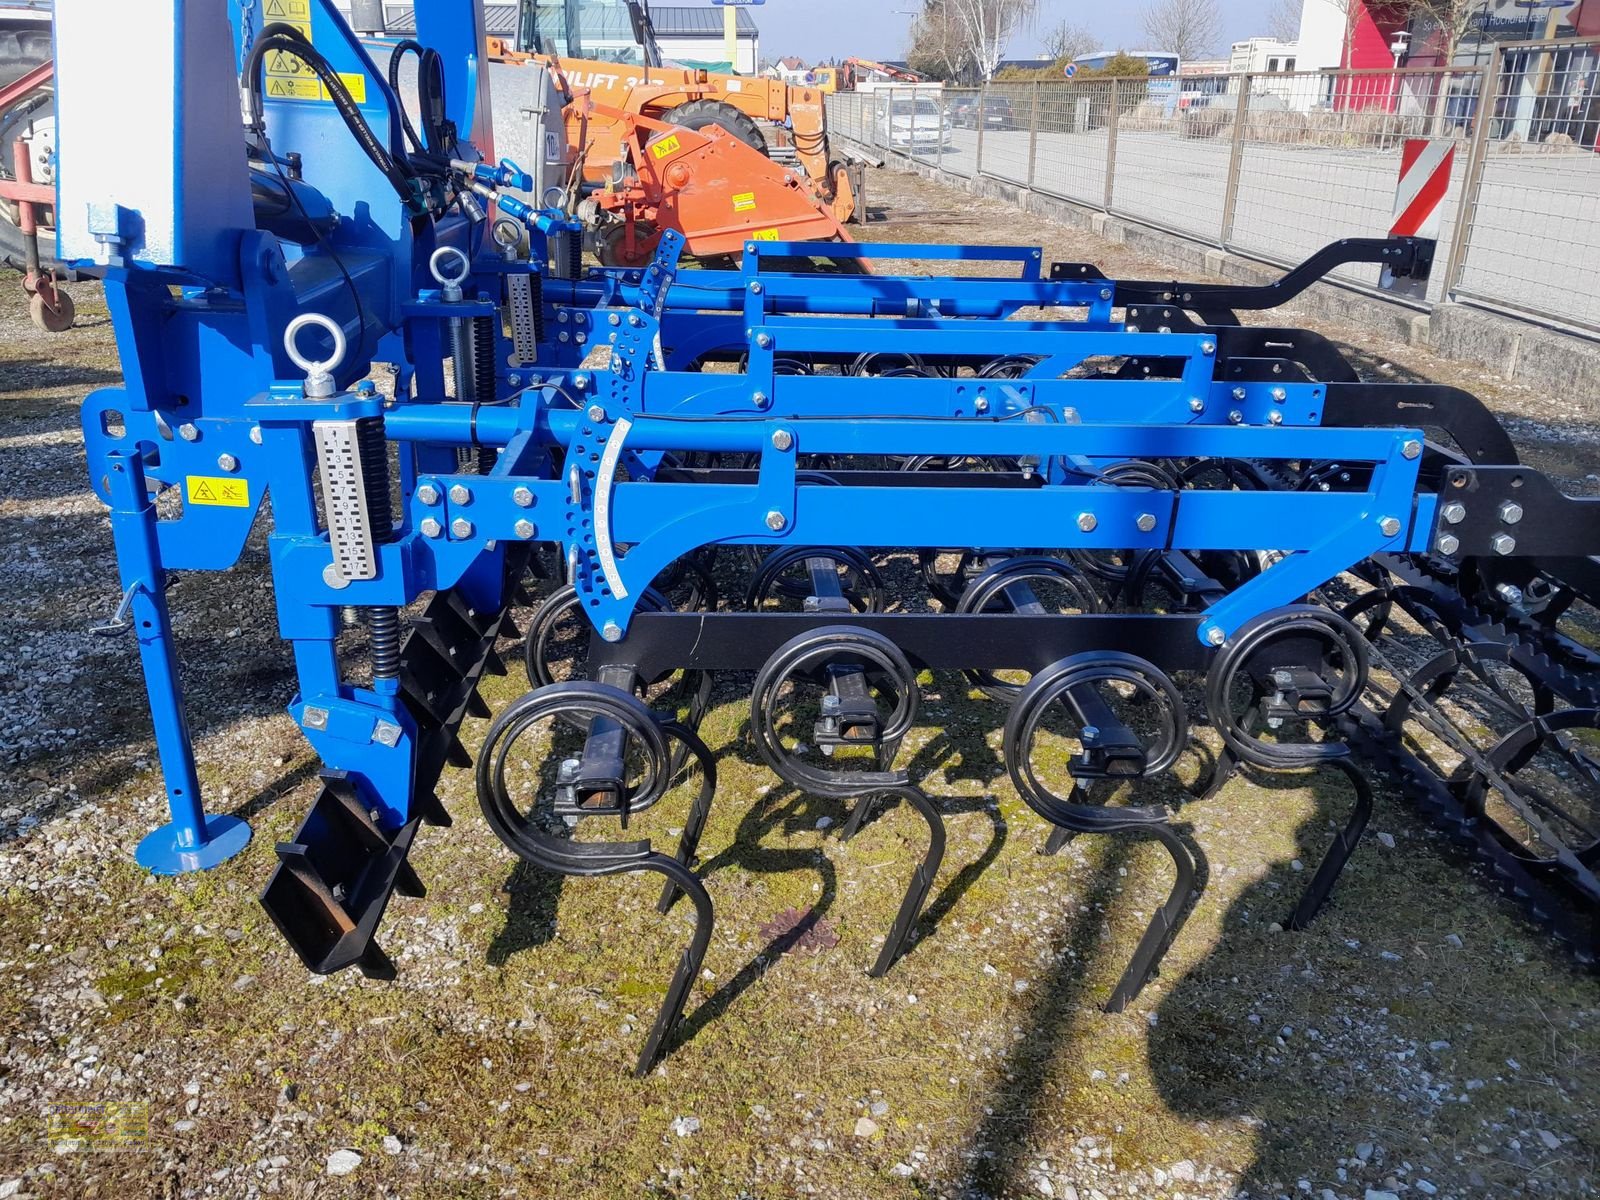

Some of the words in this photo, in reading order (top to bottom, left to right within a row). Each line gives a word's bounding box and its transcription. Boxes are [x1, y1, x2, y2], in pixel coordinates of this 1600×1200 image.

[335, 455, 341, 463] 3
[338, 471, 344, 479] 5
[340, 486, 346, 494] 7
[342, 502, 349, 510] 9
[345, 532, 356, 540] 13
[347, 547, 358, 555] 15
[349, 562, 359, 570] 17
